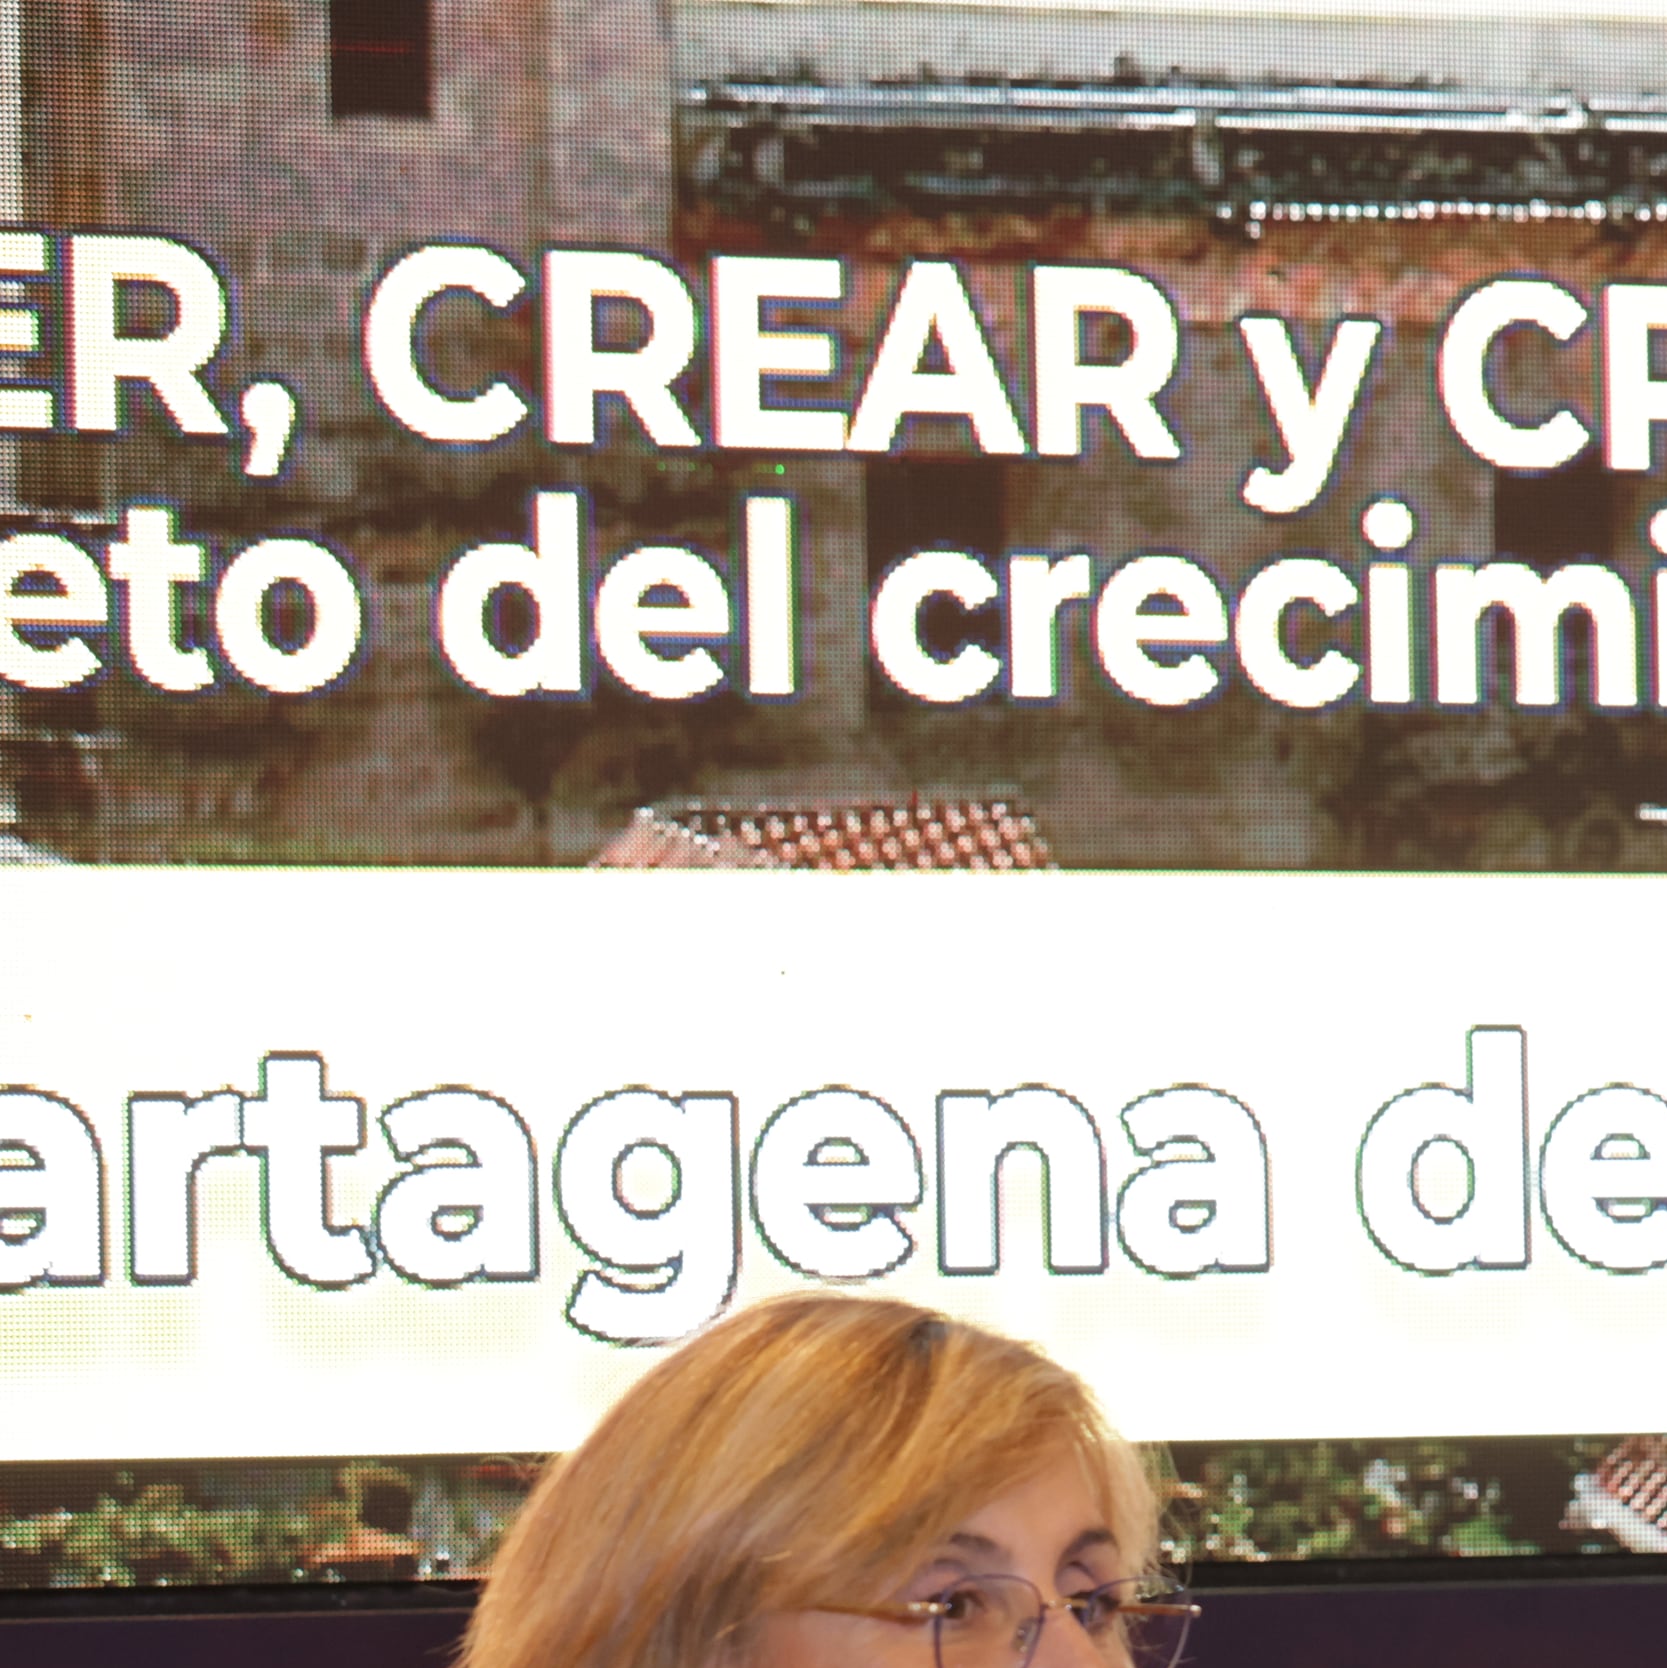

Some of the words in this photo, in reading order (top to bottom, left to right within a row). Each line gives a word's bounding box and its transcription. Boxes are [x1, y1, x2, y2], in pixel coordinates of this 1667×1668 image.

[363, 243, 1184, 460] CREAR
[1238, 315, 1384, 514] y
[0, 502, 362, 694] eto
[436, 490, 796, 698] del
